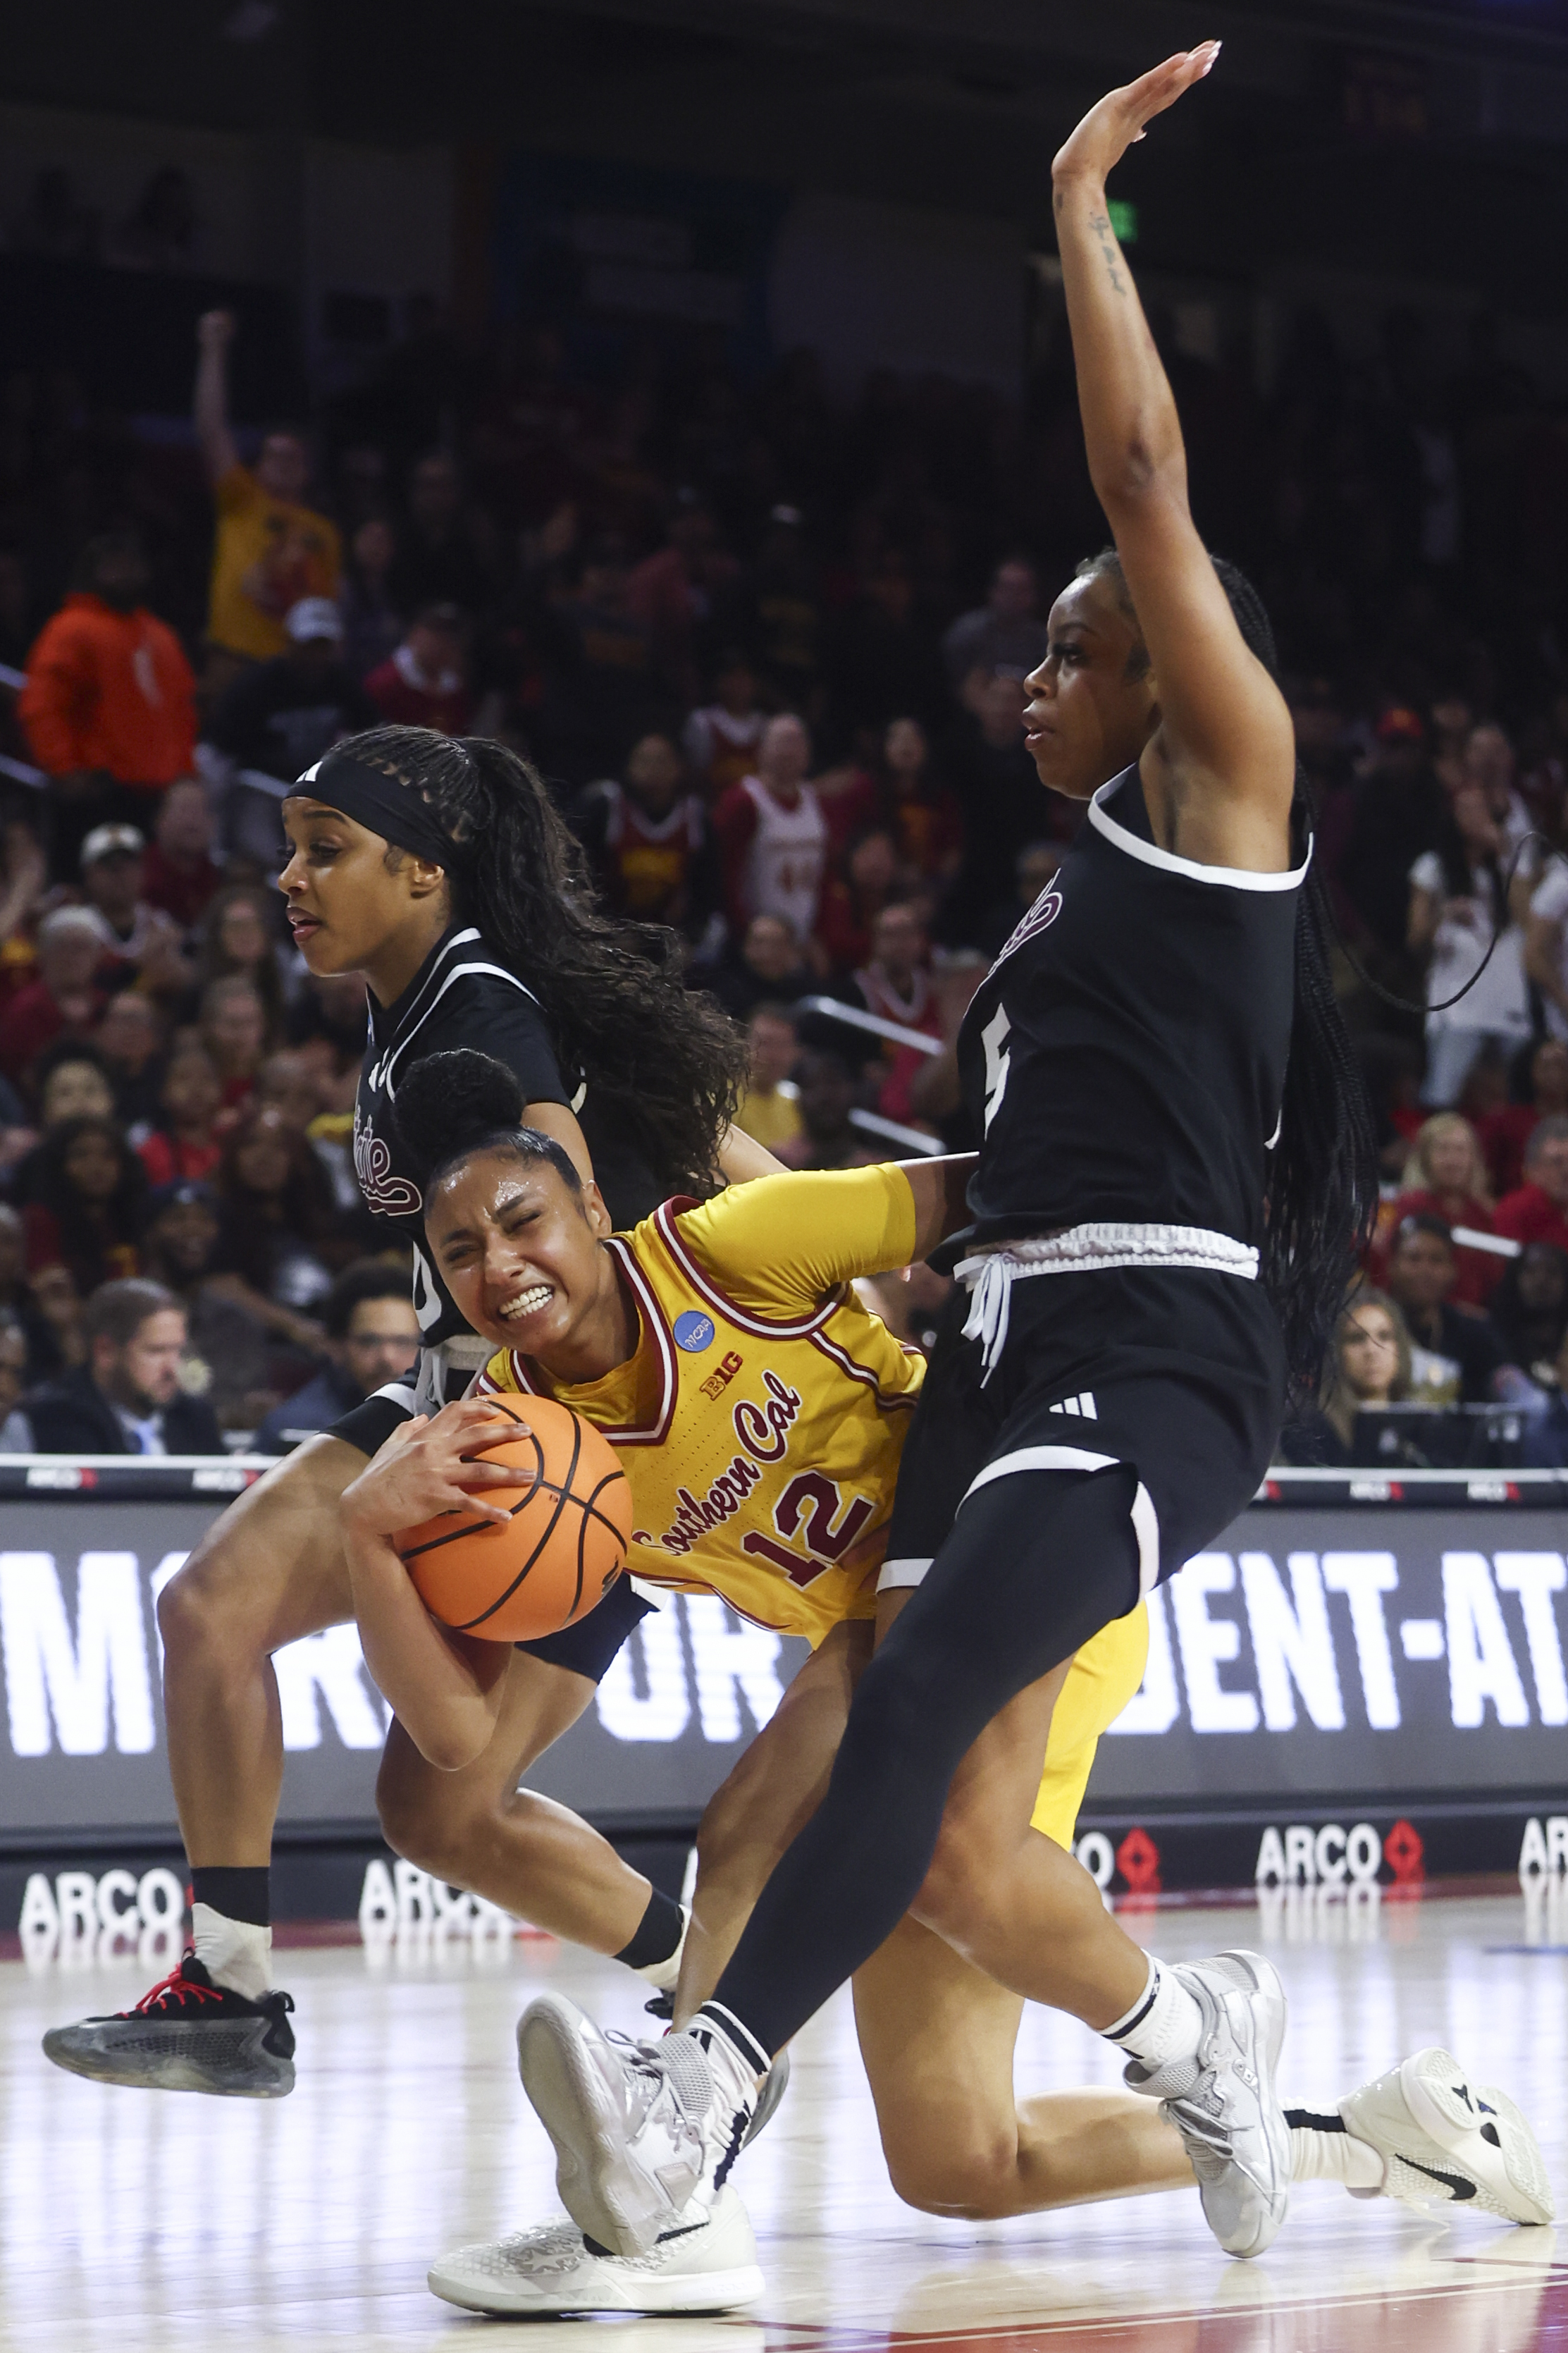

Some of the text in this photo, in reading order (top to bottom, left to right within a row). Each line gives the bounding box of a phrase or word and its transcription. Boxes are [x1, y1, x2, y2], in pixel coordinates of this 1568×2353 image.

[684, 1318, 712, 1348] NCAA
[732, 1369, 802, 1464] Cal
[741, 1470, 877, 1591] 12
[1255, 1824, 1382, 1881] ARCO
[20, 1868, 185, 1927] ARCO
